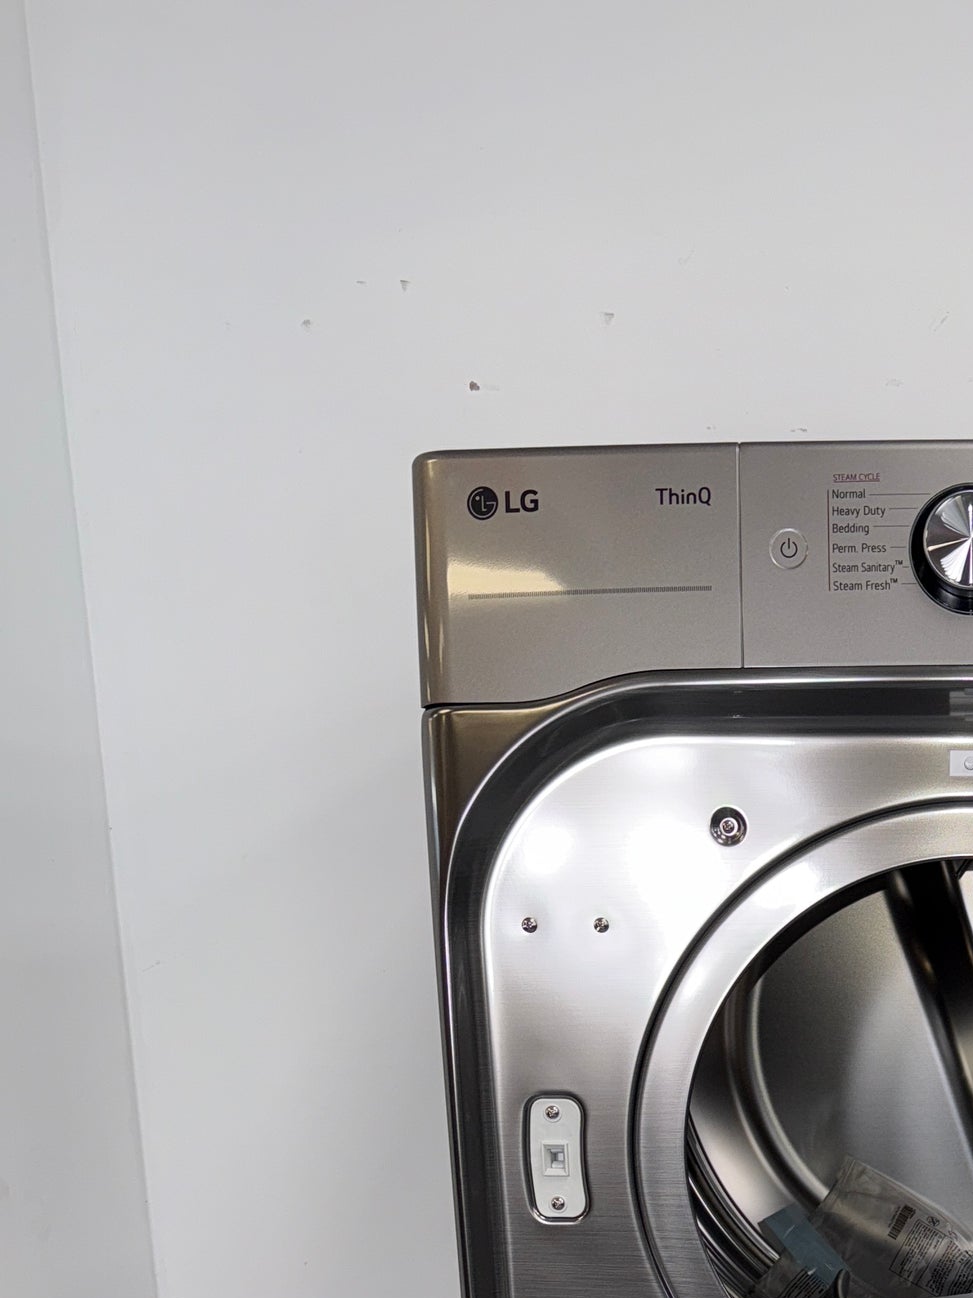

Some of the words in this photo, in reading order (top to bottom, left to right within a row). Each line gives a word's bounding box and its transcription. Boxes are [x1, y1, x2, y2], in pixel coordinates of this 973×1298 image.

[833, 473, 858, 481] STEAM
[860, 473, 880, 481] CYCLE
[655, 487, 712, 507] ThinQ
[832, 489, 866, 499] Normal
[505, 490, 539, 513] LG
[832, 506, 862, 518] Heavy
[863, 506, 886, 518] Duty
[832, 523, 869, 534] Bedding
[832, 544, 858, 553] Perm.
[861, 543, 887, 553] Press
[832, 562, 859, 573] Steam
[833, 580, 862, 591] Steam
